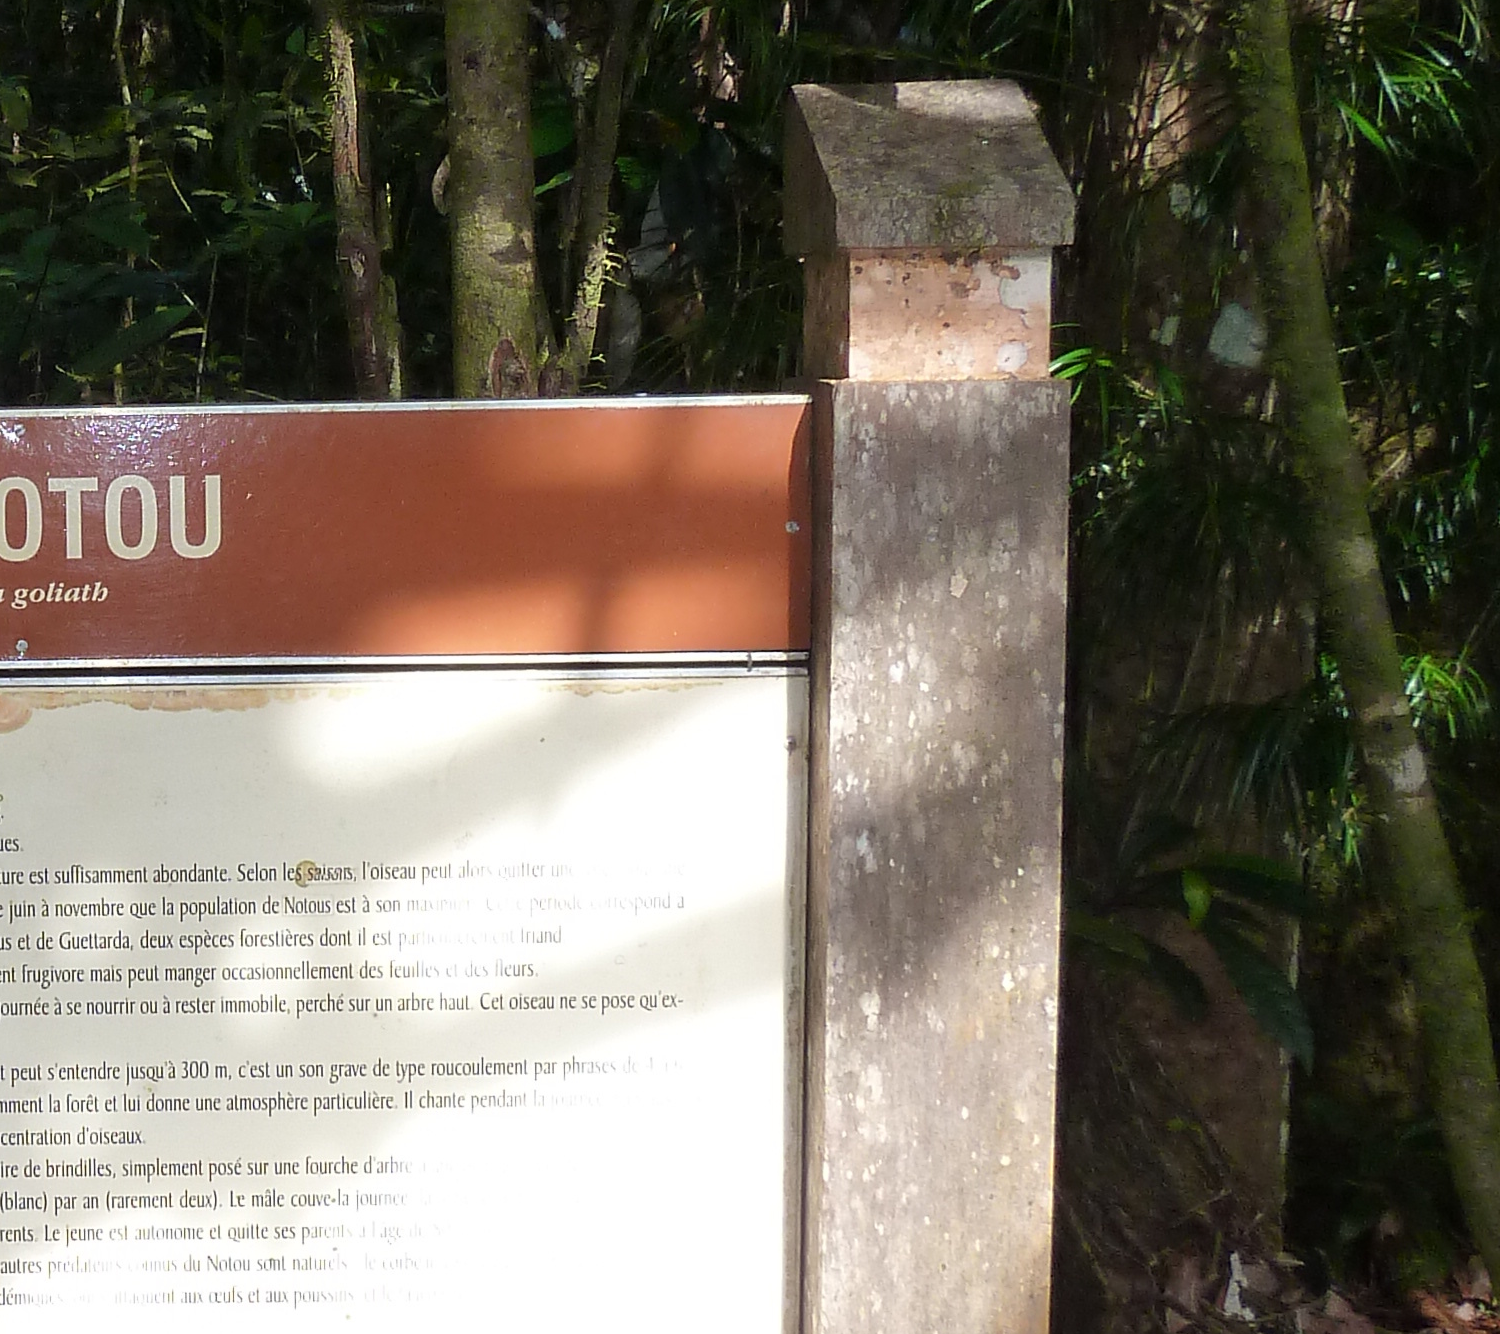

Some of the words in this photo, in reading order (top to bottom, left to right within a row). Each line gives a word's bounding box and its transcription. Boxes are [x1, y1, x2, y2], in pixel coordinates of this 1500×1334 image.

[11, 581, 109, 610] goliath
[21, 963, 85, 990] frugivore
[90, 964, 123, 982] mais
[127, 965, 160, 989] peut
[164, 967, 217, 988] manger
[221, 960, 354, 981] occasionnellement
[359, 960, 384, 980] des
[53, 997, 62, 1016] à
[66, 1001, 82, 1016] se
[86, 997, 136, 1015] nourrir
[139, 1001, 158, 1015] ou
[162, 994, 171, 1014] à
[175, 997, 216, 1014] rester
[220, 994, 291, 1014] immobile,
[296, 993, 345, 1019] perché
[348, 998, 371, 1012] sur
[375, 998, 393, 1012] un
[397, 992, 434, 1012] arbre
[439, 992, 472, 1010] haut.
[479, 993, 504, 1011] Cet
[508, 993, 555, 1010] oiseau
[559, 996, 577, 1009] ne
[581, 996, 597, 1010] se
[601, 995, 636, 1015] pose
[639, 991, 684, 1011] qu'ex-
[76, 1126, 145, 1145] d'oiseaux.
